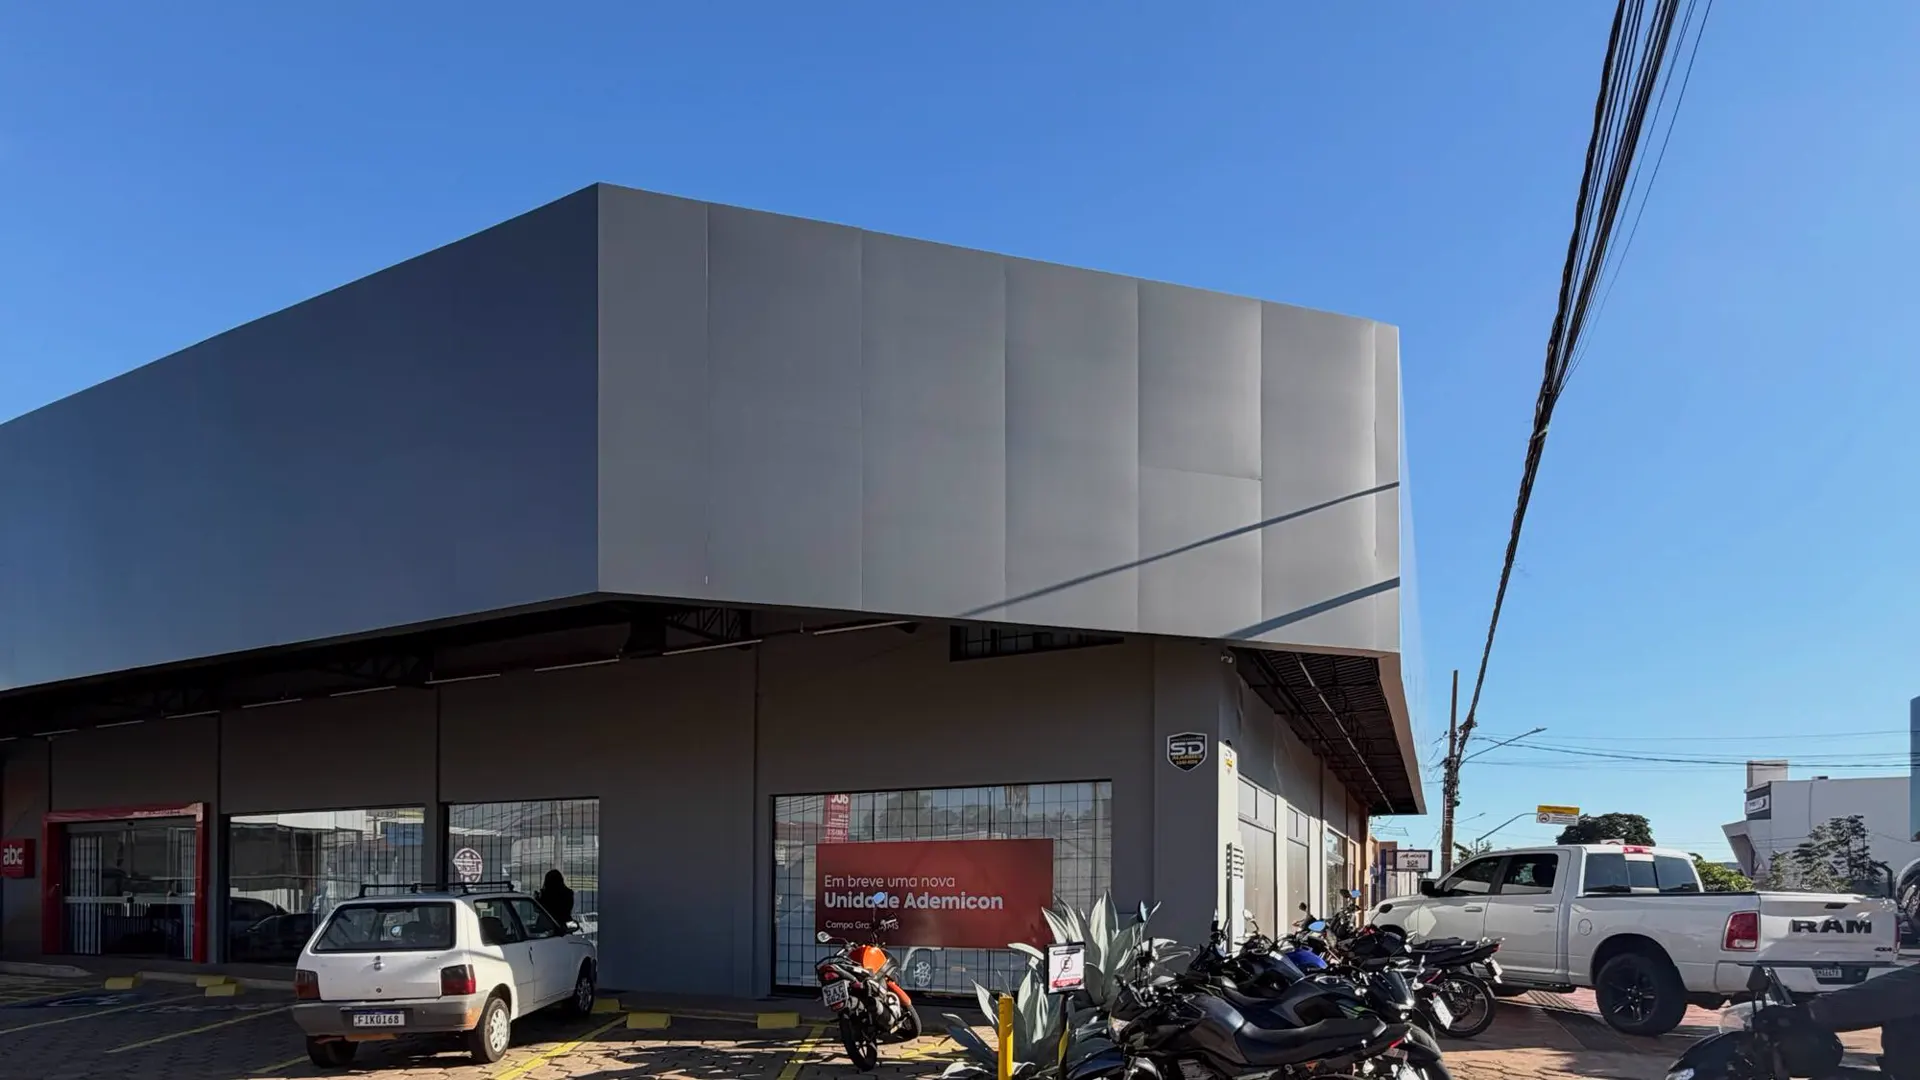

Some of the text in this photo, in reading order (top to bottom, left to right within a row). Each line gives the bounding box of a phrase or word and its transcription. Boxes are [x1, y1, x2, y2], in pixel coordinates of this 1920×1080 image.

[1170, 741, 1204, 756] SD
[3, 844, 24, 865] abc
[824, 875, 955, 887] Em breve uma nova
[824, 891, 1003, 909] Unidade Ademicon
[825, 920, 853, 930] Campo
[1788, 919, 1872, 933] RAM
